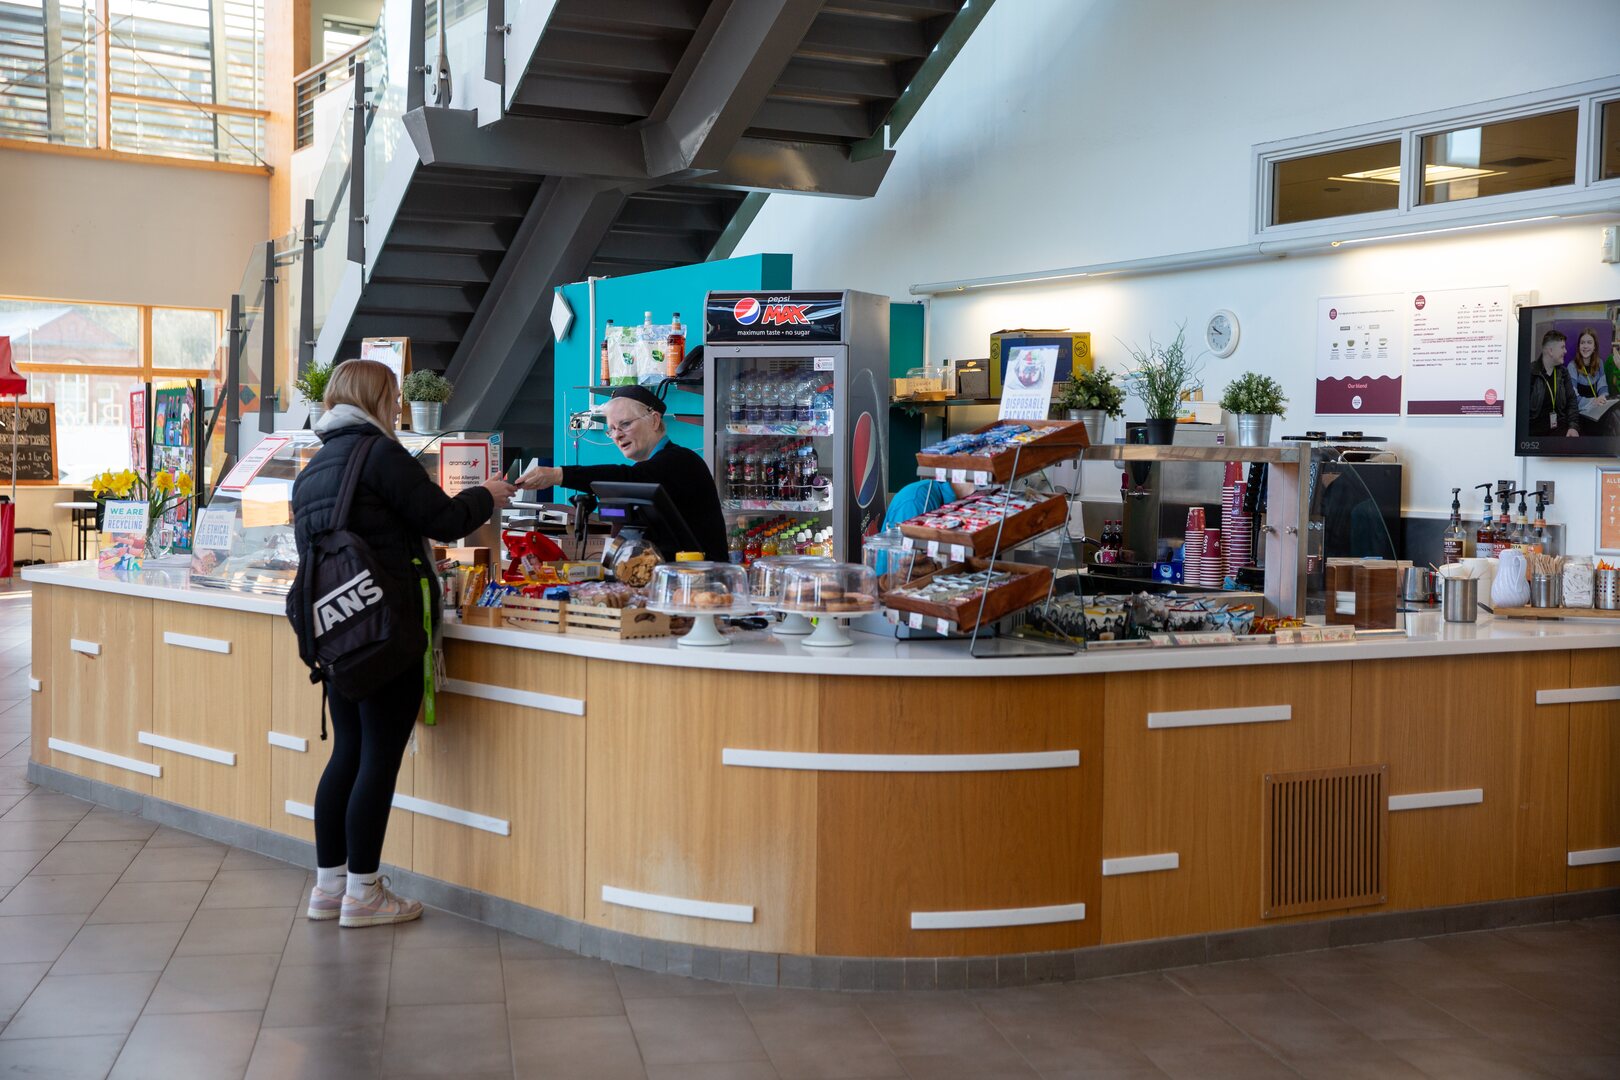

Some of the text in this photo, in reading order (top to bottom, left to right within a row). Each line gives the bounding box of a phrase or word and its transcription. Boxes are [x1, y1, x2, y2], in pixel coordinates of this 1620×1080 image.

[761, 304, 814, 326] MAX
[1006, 398, 1044, 409] DISPOSABLE
[1520, 441, 1540, 450] 09:52
[108, 520, 143, 529] RECYCLING
[196, 535, 228, 546] SOURCING
